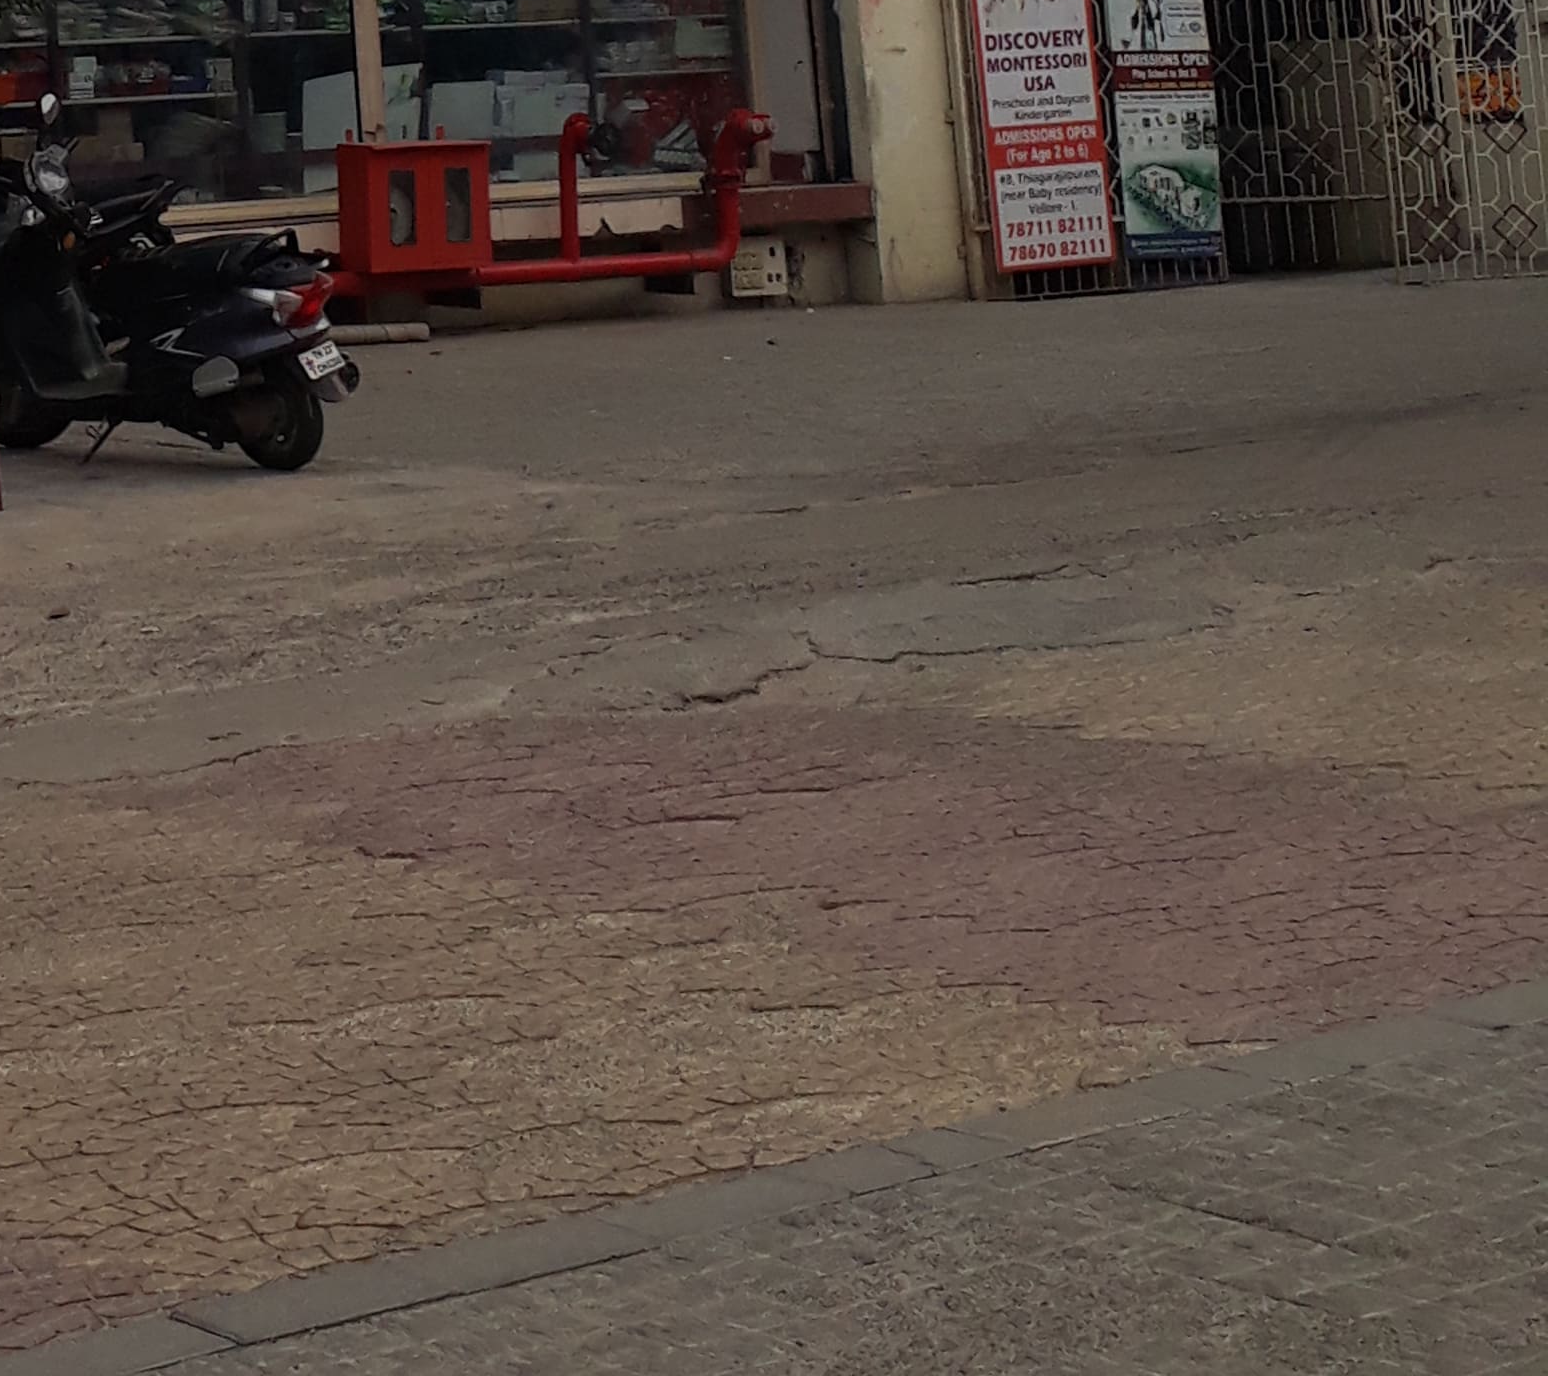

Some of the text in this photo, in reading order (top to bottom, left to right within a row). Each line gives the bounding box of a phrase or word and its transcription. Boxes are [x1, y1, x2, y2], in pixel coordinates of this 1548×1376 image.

[984, 28, 1085, 52] DISCOVERY
[986, 52, 1088, 74] MONTESSORI
[1181, 52, 1210, 67] OPEN
[1023, 75, 1056, 92] USA
[994, 125, 1097, 146] ADMISSIONS OPEN
[1006, 148, 1029, 167] (For
[1030, 146, 1052, 163] Age
[1063, 144, 1075, 159] to
[1006, 216, 1103, 239] 78711 82111
[1008, 239, 1105, 262] 78670 82111
